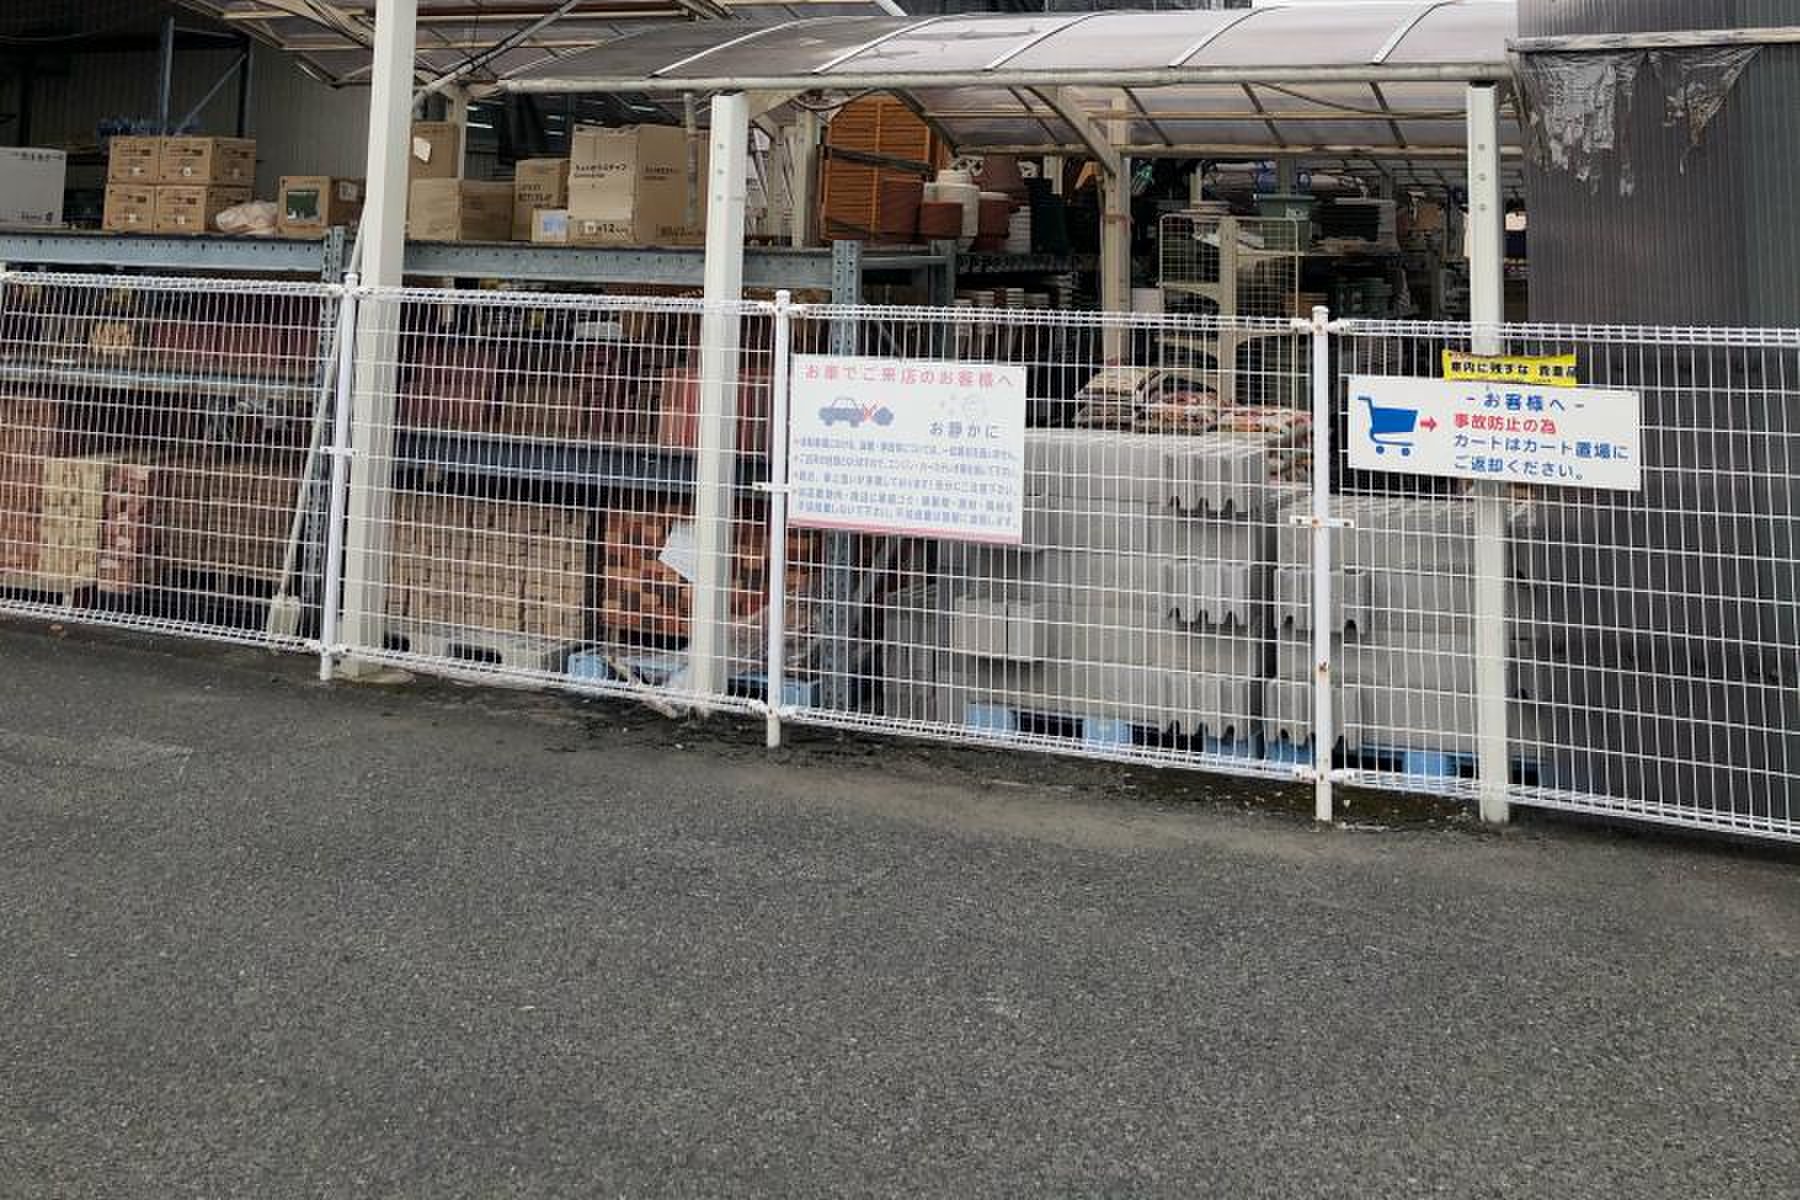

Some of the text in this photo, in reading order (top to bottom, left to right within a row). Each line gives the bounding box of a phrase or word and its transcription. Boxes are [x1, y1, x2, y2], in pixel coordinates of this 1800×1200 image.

[804, 365, 1014, 388] お車でご来店のお客様へ
[928, 420, 1002, 440] お静かに
[1454, 412, 1557, 435] 事故防止の為
[1454, 433, 1629, 460] カートはカート置場に
[1454, 454, 1584, 481] ご返却ください。
